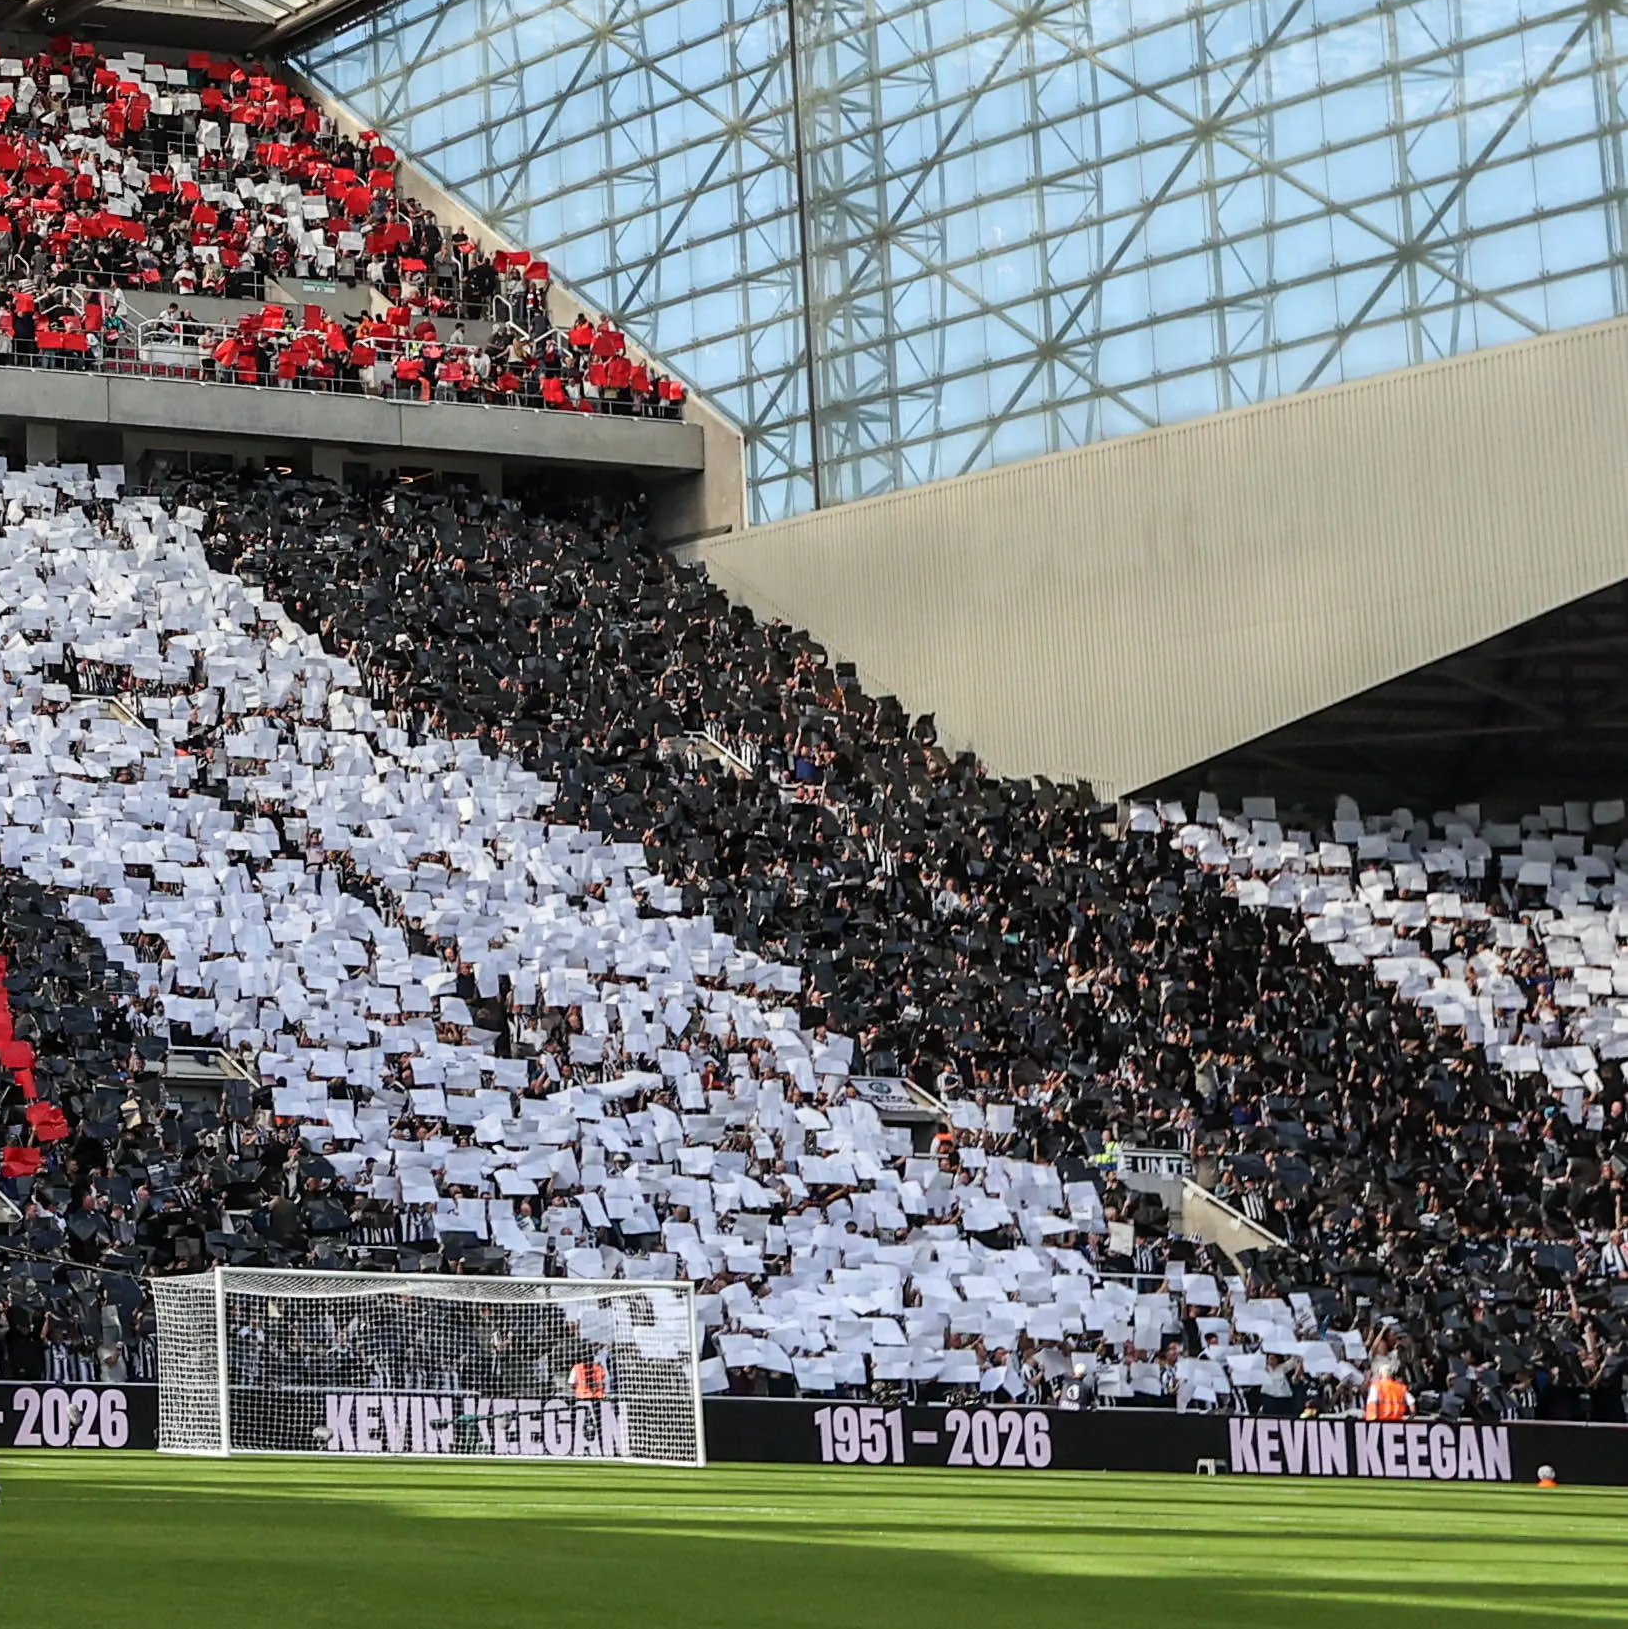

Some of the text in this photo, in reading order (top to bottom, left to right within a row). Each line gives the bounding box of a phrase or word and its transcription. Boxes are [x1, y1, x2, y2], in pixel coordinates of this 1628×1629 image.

[1137, 1157, 1196, 1176] UNITE
[13, 1387, 128, 1448] 2026
[325, 1394, 627, 1456] KEVIN KEEGAN
[814, 1406, 905, 1464] 1951
[945, 1409, 1052, 1468] 2026
[1228, 1417, 1512, 1481] KEVIN KEEGAN
